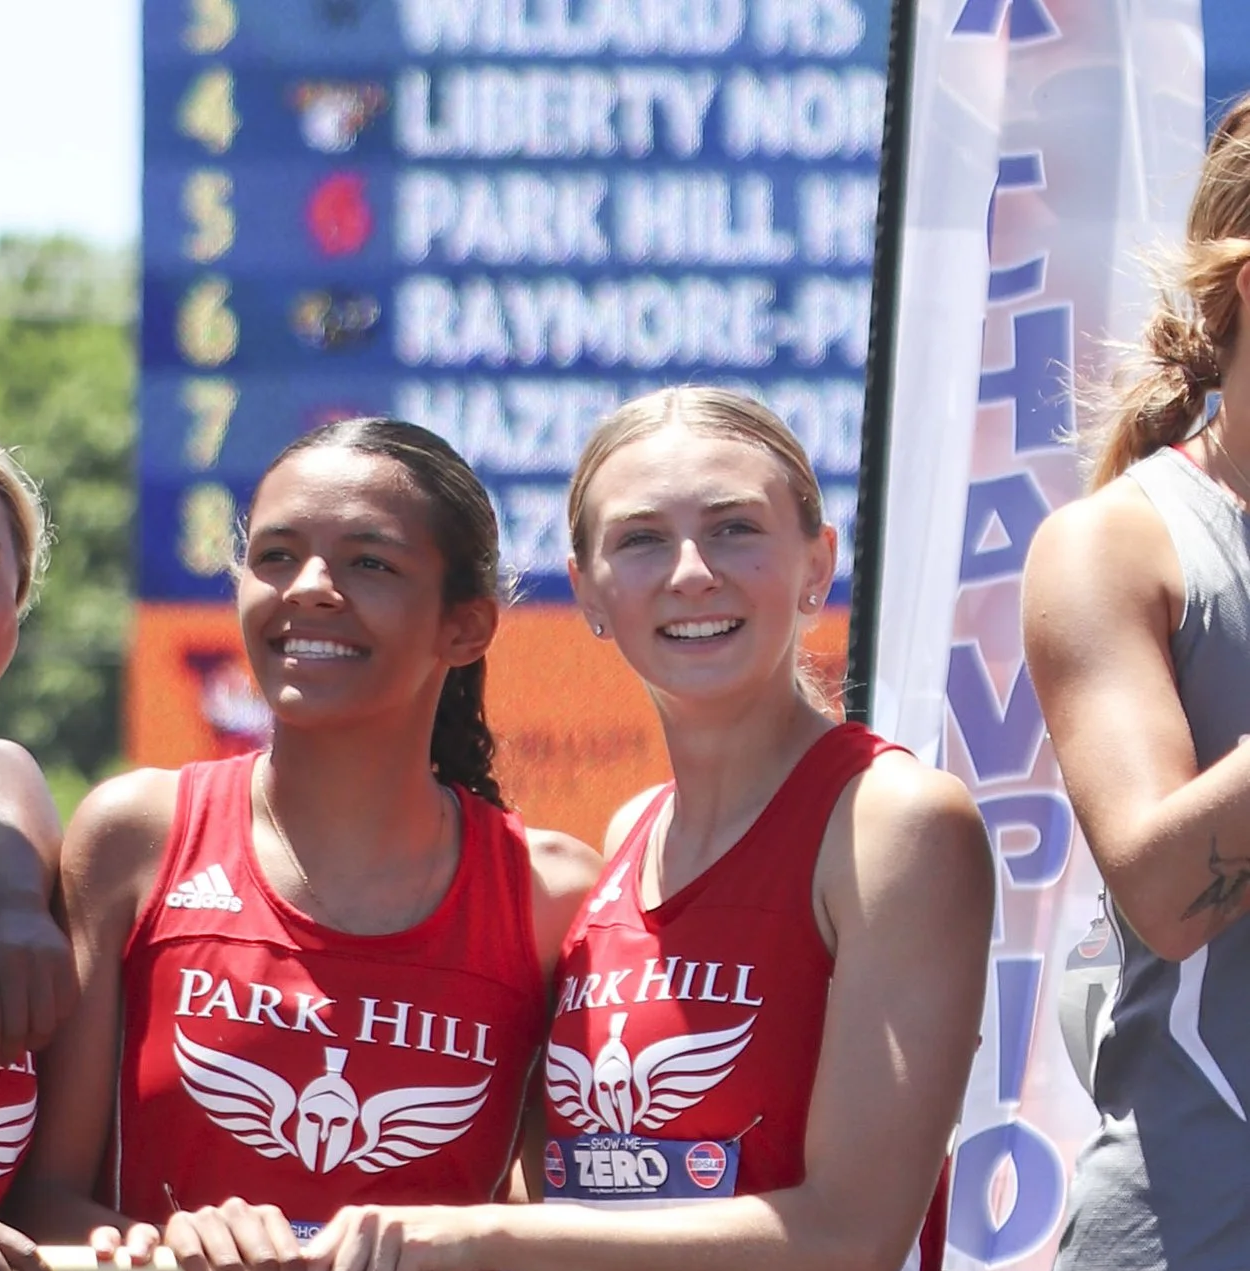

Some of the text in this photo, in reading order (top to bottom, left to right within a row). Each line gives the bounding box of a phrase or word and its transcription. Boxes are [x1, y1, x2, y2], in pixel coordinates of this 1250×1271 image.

[177, 66, 242, 153] 4
[396, 66, 718, 158] LIBERTY
[180, 166, 238, 262] 5
[396, 172, 612, 264] PARK
[614, 172, 796, 264] HILL
[176, 273, 240, 366] 6
[182, 375, 240, 470] 7
[165, 892, 243, 913] adidas
[174, 968, 497, 1066] PARK HILL
[634, 956, 764, 1006] HILL
[574, 1149, 669, 1188] ZERO
[591, 1136, 642, 1150] SHOW-ME
